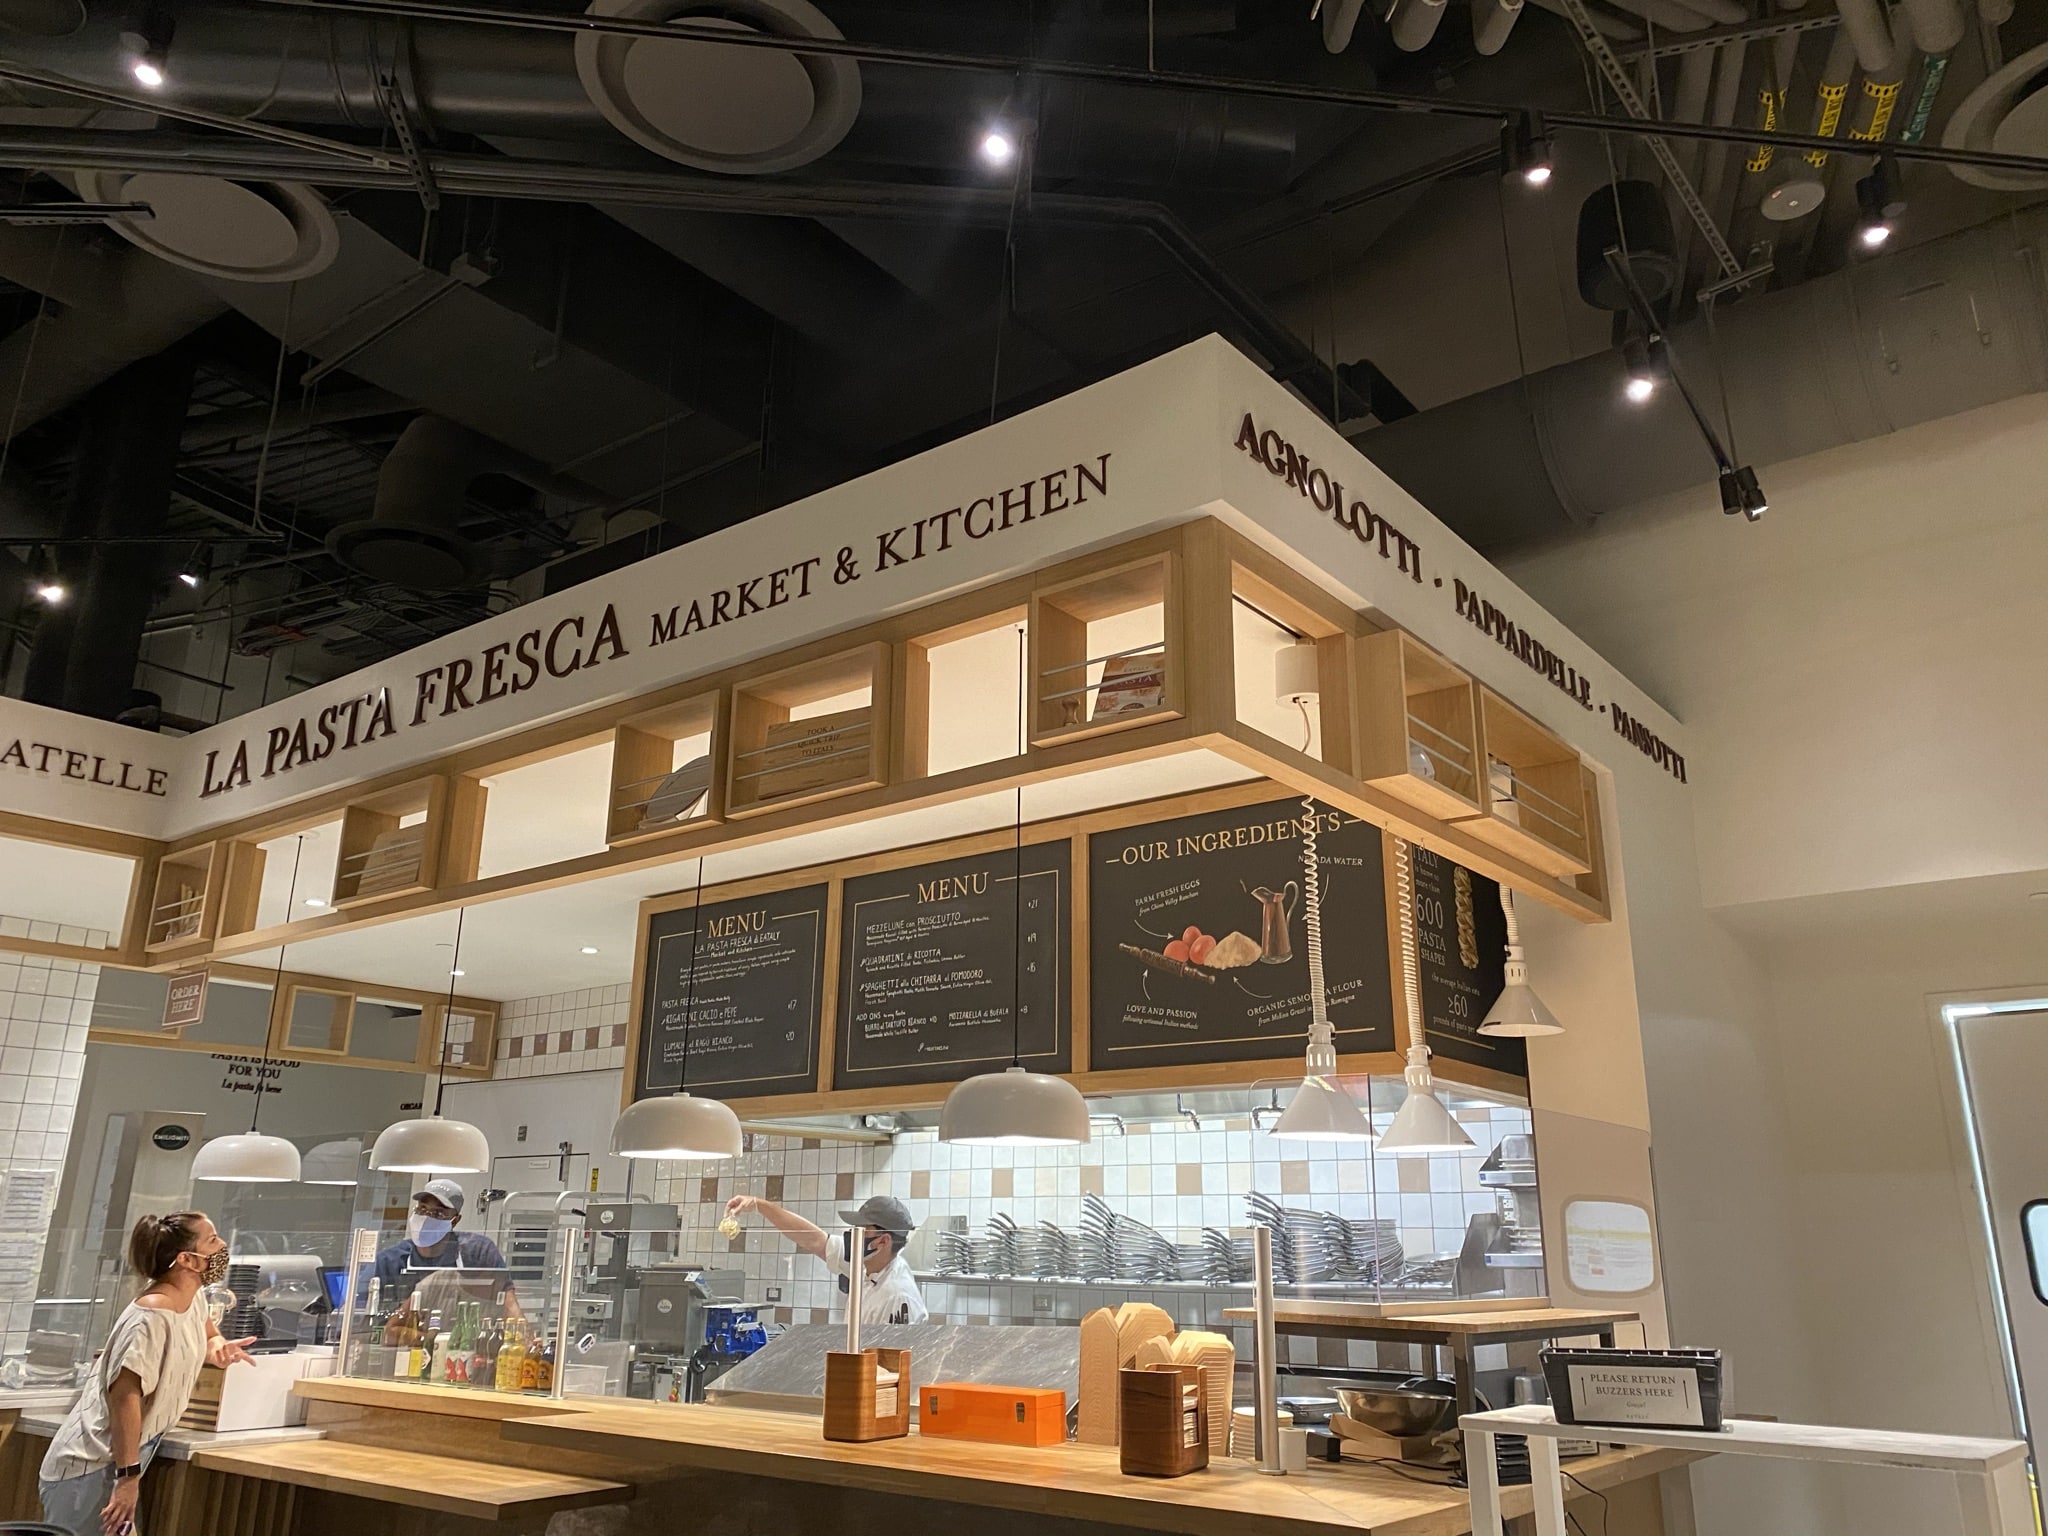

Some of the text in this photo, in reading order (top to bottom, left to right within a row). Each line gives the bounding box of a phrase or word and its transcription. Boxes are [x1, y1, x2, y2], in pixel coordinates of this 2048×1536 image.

[1233, 413, 1423, 584] AGNOLOTTI
[1453, 578, 1593, 712] PAPPARDELLE
[1611, 702, 1688, 785] PANSOTTI
[199, 453, 1112, 798] LA PASTA FRESCA MARKET & KITCHEN
[1121, 811, 1341, 865] OUR INGREDIENTS
[1333, 857, 1363, 866] WATER
[1411, 844, 1439, 868] ITALY
[917, 871, 989, 905] MENU
[1135, 879, 1201, 907] FARM FRESH EGGS
[1416, 893, 1443, 929] 600
[707, 910, 767, 939] MENU
[866, 920, 905, 933] MEZZELUNE
[917, 912, 961, 926] PROSCIUTTO
[695, 943, 705, 954] LA
[707, 940, 729, 952] PASTA
[730, 934, 752, 948] FRESCA
[760, 931, 780, 943] EATALY
[1418, 927, 1446, 952] PASTA
[865, 952, 905, 966] QUADRATINI
[914, 948, 942, 960] RICOTTA
[1420, 948, 1446, 966] SHAPES
[864, 978, 899, 993] SPAGHETTI
[910, 974, 942, 987] CHITARRA
[950, 969, 984, 982] POMODORO
[171, 984, 199, 1000] ORDER
[1246, 979, 1364, 1018] ORGANIC SEMOA FLOUR
[171, 999, 194, 1014] HERE
[662, 999, 678, 1009] PASTA
[699, 1008, 718, 1020] CACIO
[724, 1006, 738, 1018] PEPE
[1126, 1004, 1198, 1020] LOVE AND PASSION
[855, 1012, 868, 1022] ADD
[885, 1018, 906, 1029] TARTUFO
[908, 1016, 927, 1026] BIANCO
[948, 1010, 982, 1021] MOZZARELLA
[990, 1008, 1010, 1017] BUFALA
[663, 1041, 686, 1051] LUMACH
[712, 1035, 733, 1047] BIANCO
[228, 1063, 282, 1080] FOR YOU
[1589, 1374, 1676, 1384] PLEASE RETURN
[1595, 1386, 1675, 1398] BUZZERS HERE
